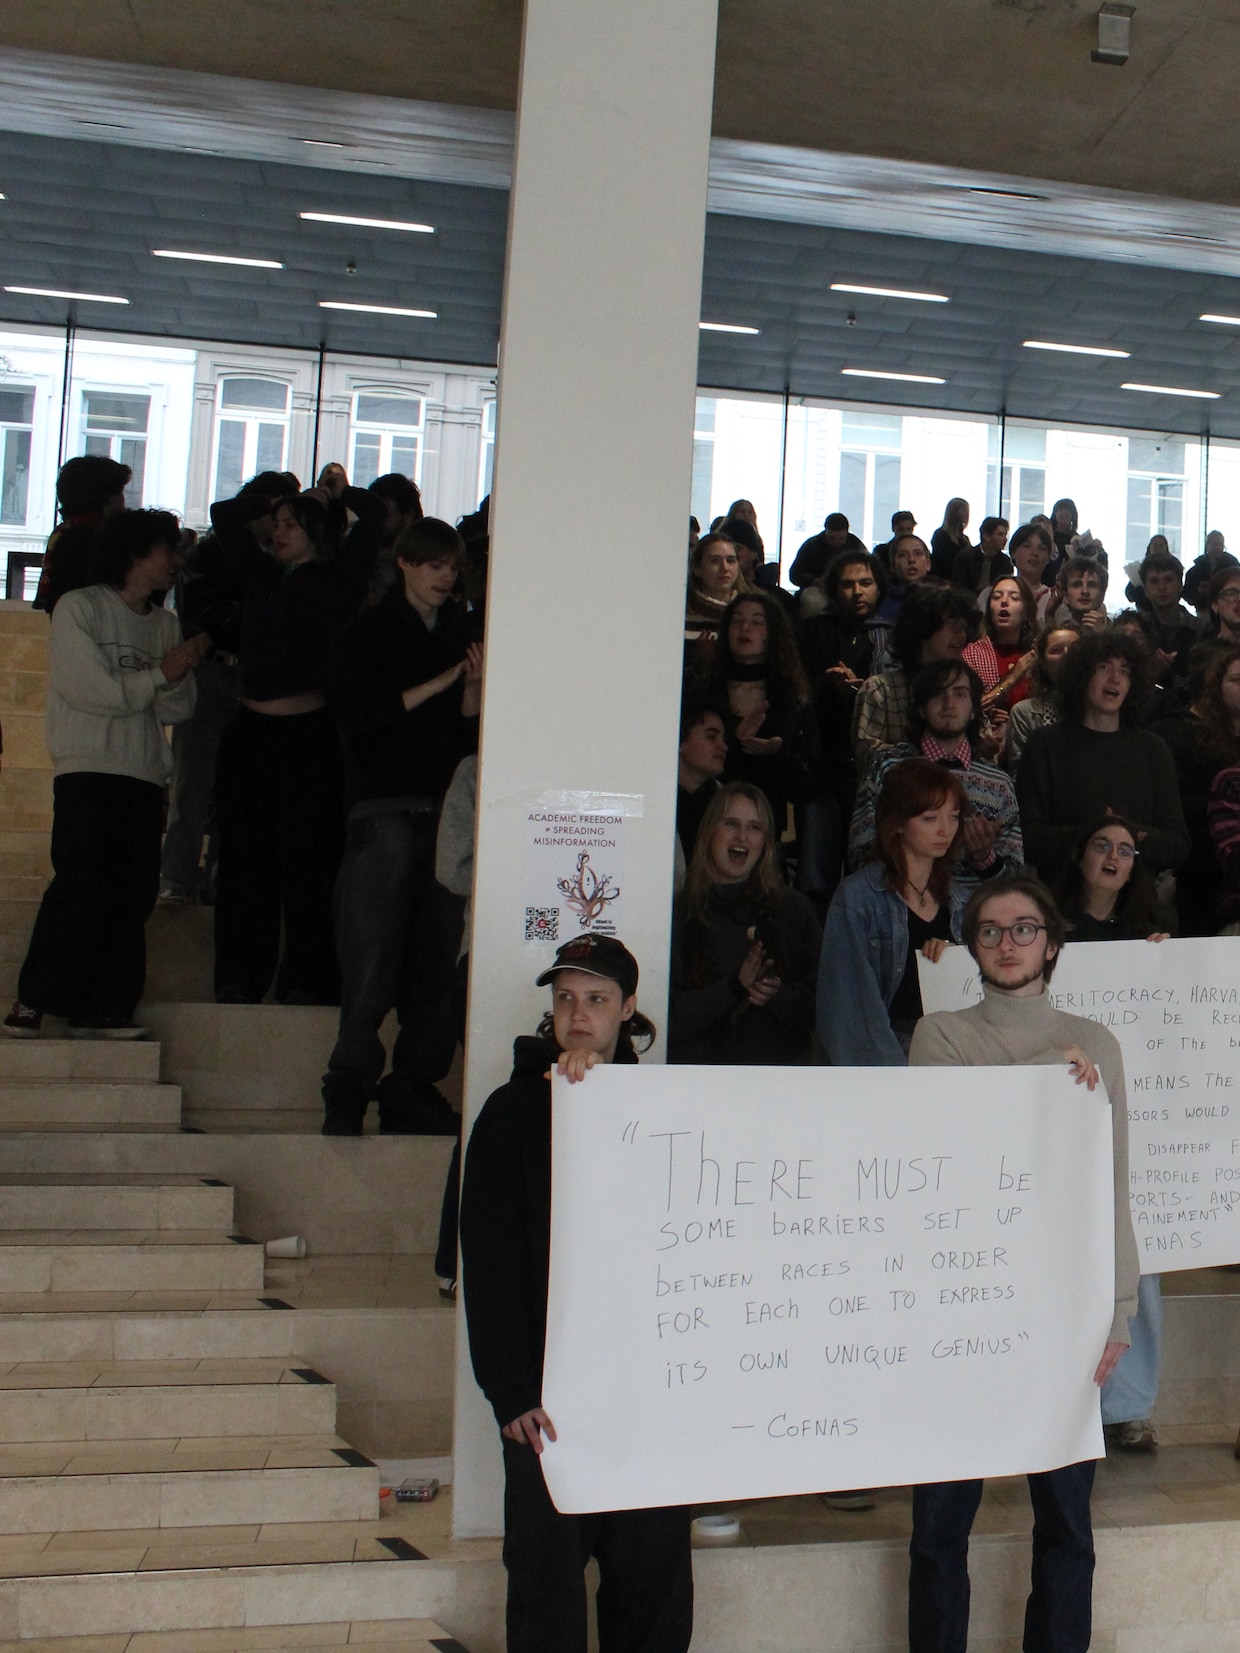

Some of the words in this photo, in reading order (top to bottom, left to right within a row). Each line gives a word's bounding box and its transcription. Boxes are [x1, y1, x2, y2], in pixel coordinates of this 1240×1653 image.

[528, 813, 577, 823] ACADEMIC
[579, 815, 622, 824] FREEDOM
[553, 826, 605, 836] SPREADING
[533, 838, 616, 848] MISINFORMATION
[1146, 1038, 1165, 1051] OF
[1133, 1074, 1191, 1092] MEANS
[1184, 1105, 1230, 1119] WOULD
[1147, 1143, 1211, 1156] DISAPPEAR
[857, 1156, 953, 1201] MUST
[655, 1217, 737, 1252] SOME
[923, 1207, 971, 1231] SET
[996, 1206, 1023, 1226] UP
[781, 1260, 851, 1281] RACES
[884, 1254, 904, 1273] IN
[931, 1246, 1009, 1271] ORDER
[656, 1306, 710, 1340] FOR
[828, 1295, 871, 1317] ONE
[888, 1290, 916, 1312] TO
[939, 1284, 1015, 1305] EXPRESS
[739, 1348, 789, 1373] OWN
